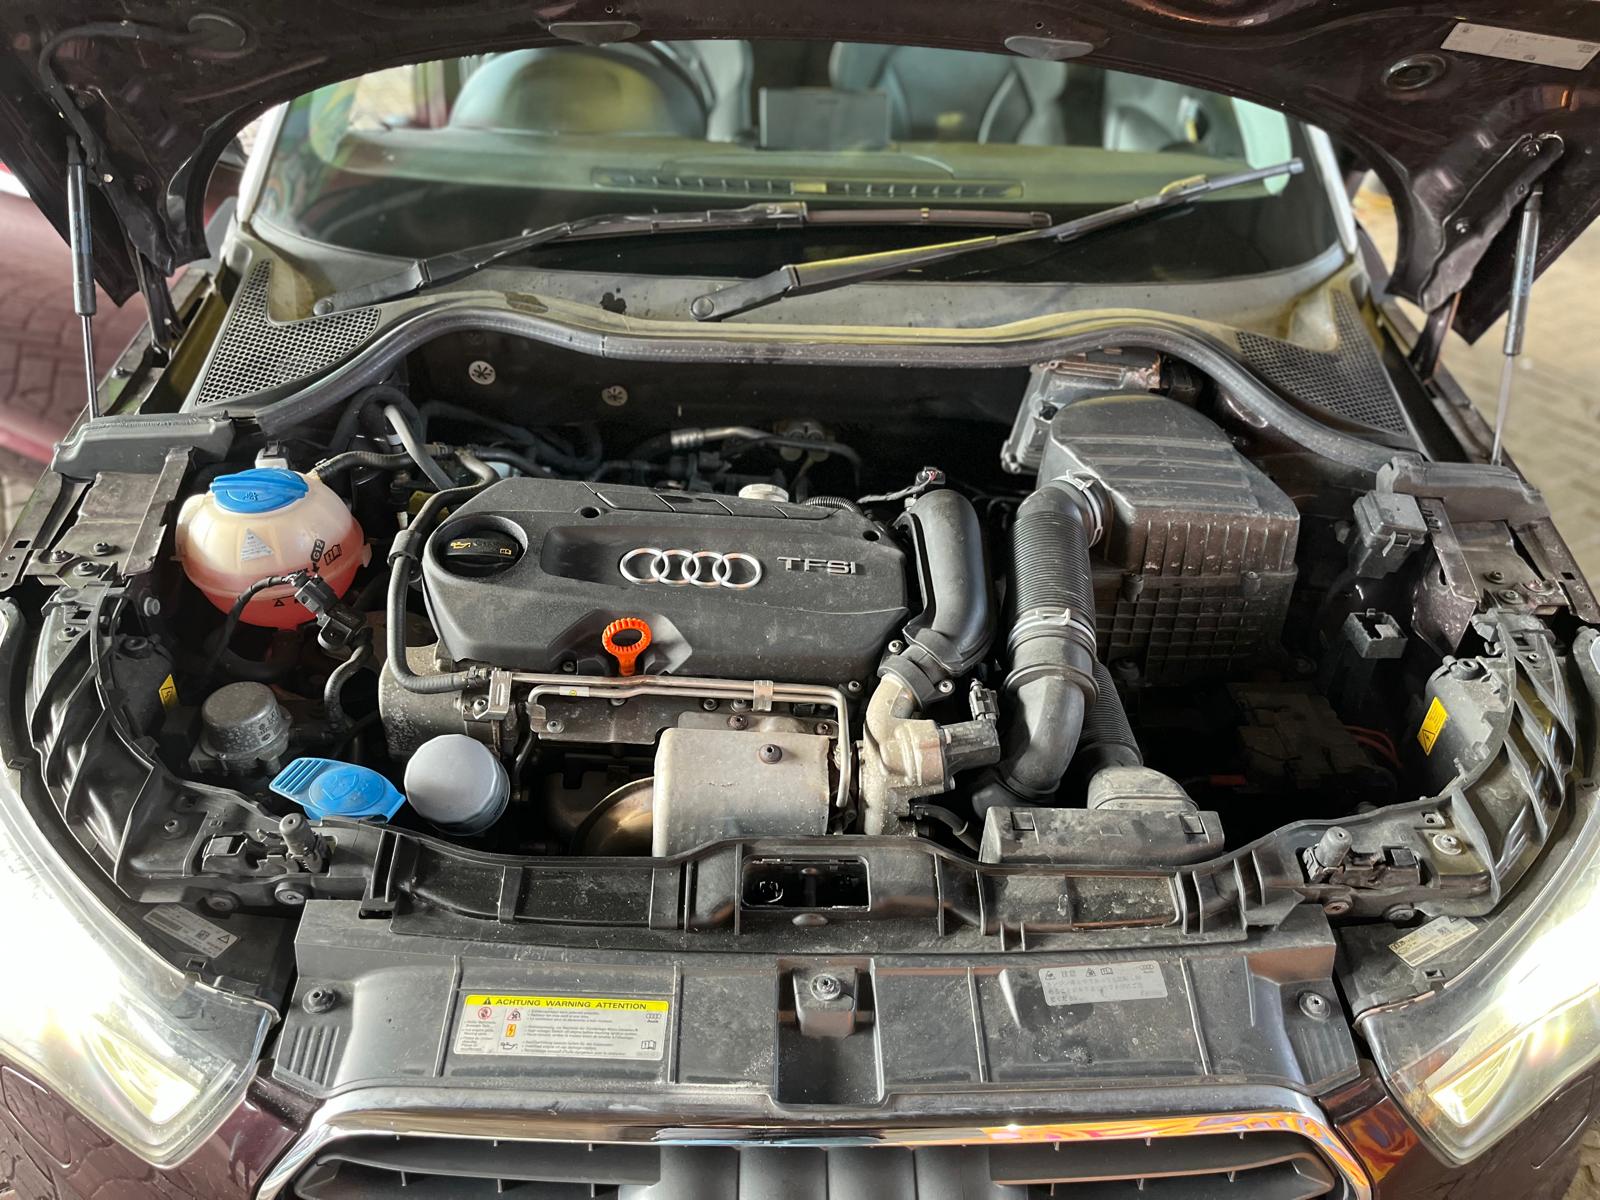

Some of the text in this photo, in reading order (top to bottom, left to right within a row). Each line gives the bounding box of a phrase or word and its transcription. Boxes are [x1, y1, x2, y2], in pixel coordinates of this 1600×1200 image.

[312, 540, 324, 559] G12
[776, 556, 857, 575] TFSI
[495, 998, 647, 1010] ACHTUNG WARNING ATTENTION
